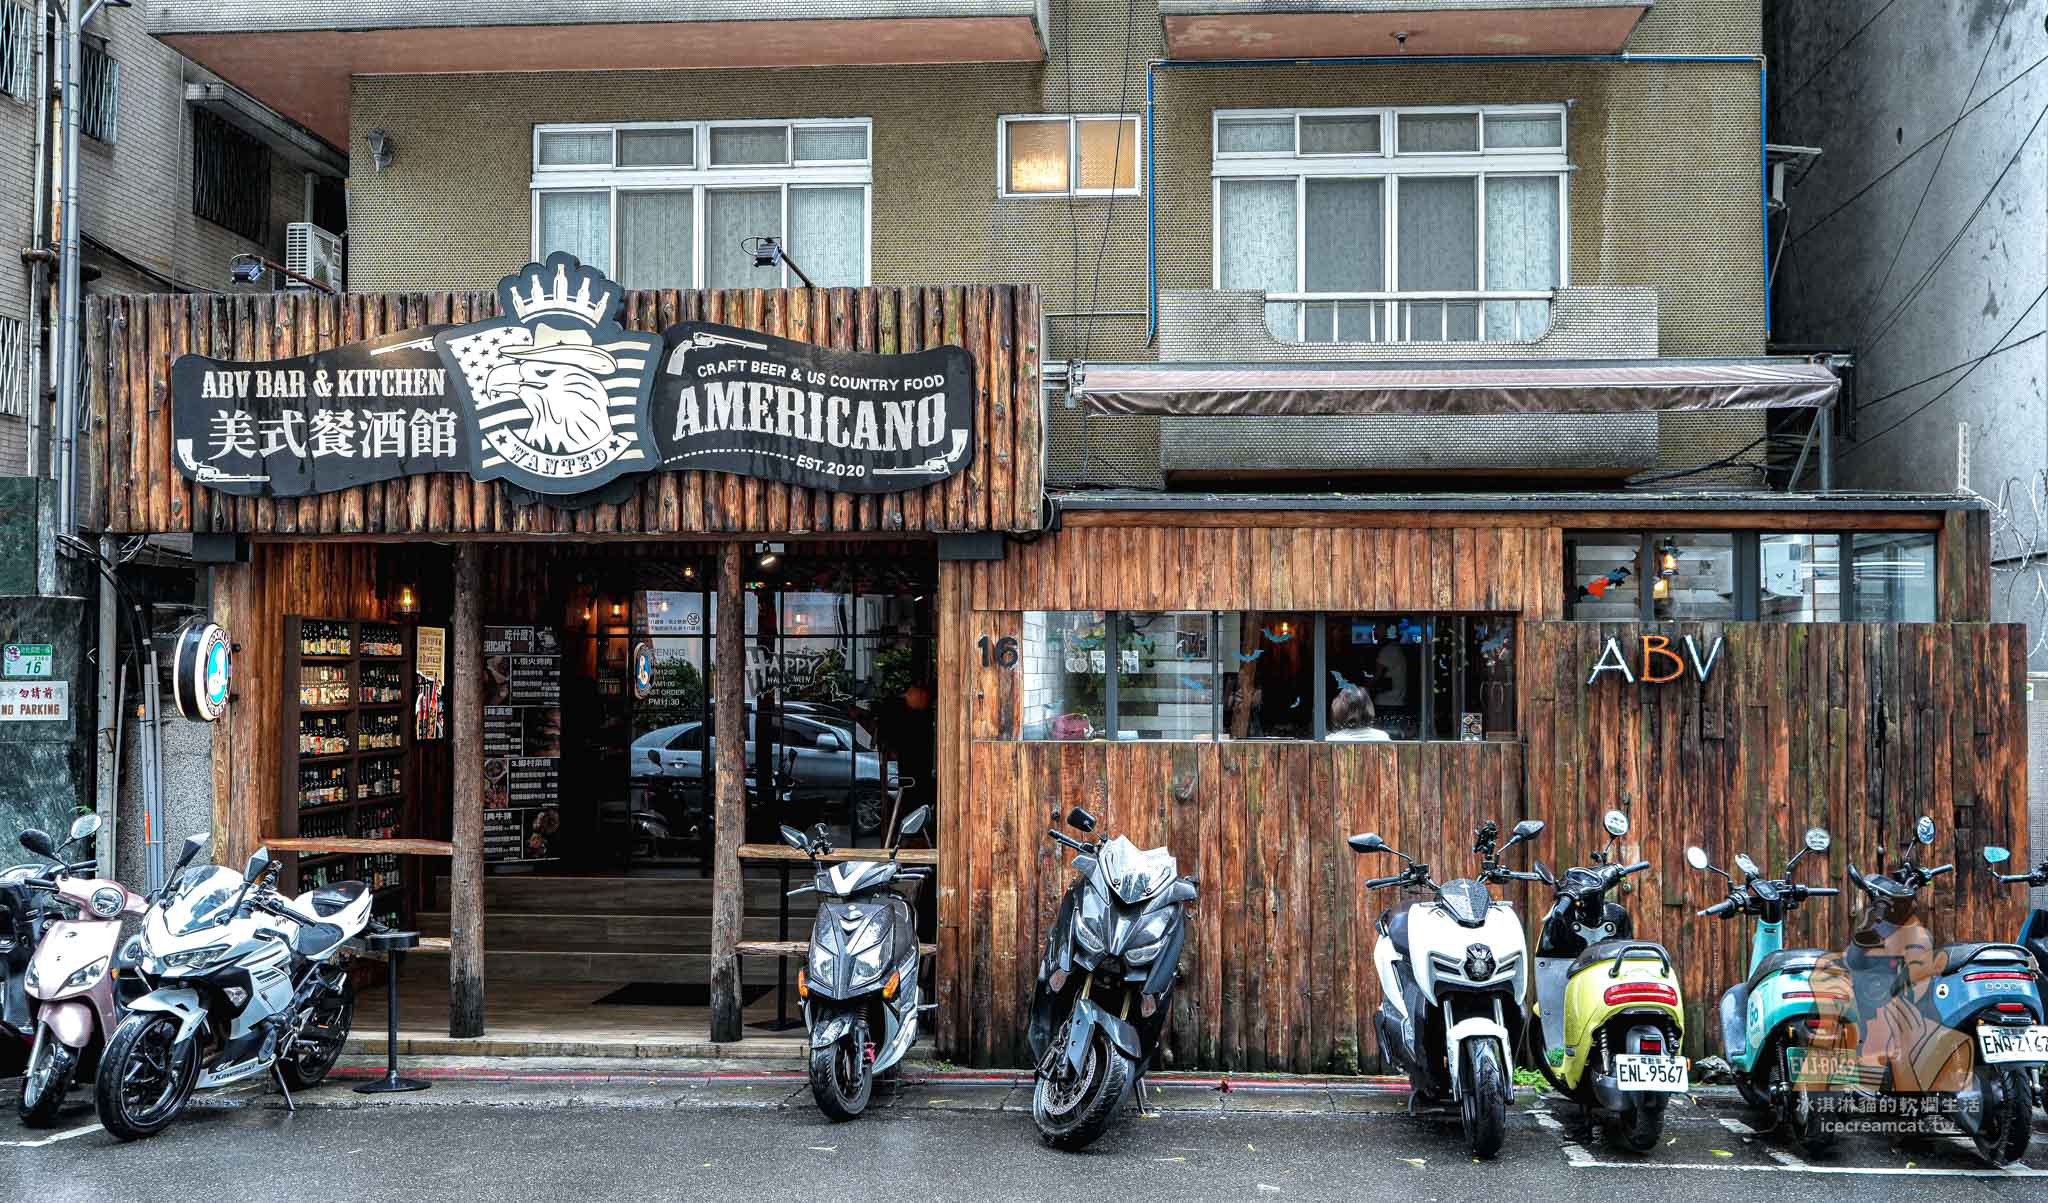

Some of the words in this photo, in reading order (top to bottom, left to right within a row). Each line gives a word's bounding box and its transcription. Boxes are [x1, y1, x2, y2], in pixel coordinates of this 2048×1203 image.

[201, 371, 250, 399] ABV
[255, 370, 307, 398] BAR
[312, 371, 335, 397] &
[337, 368, 447, 398] KITCHEN
[698, 359, 747, 378] CRAFT
[751, 361, 787, 378] BEER
[791, 368, 802, 382] &
[807, 371, 826, 385] US
[830, 374, 899, 392] COUNTRY
[904, 374, 945, 391] FOOD
[672, 381, 947, 451] AMERICANO
[207, 407, 459, 461] 美式餐酒館
[509, 443, 608, 476] WANTED
[796, 454, 866, 478] EST.2020
[25, 662, 42, 674] 16
[977, 635, 1019, 669] 16
[1587, 633, 1723, 686] ABV
[1, 704, 14, 715] NO
[20, 704, 60, 715] PARKING
